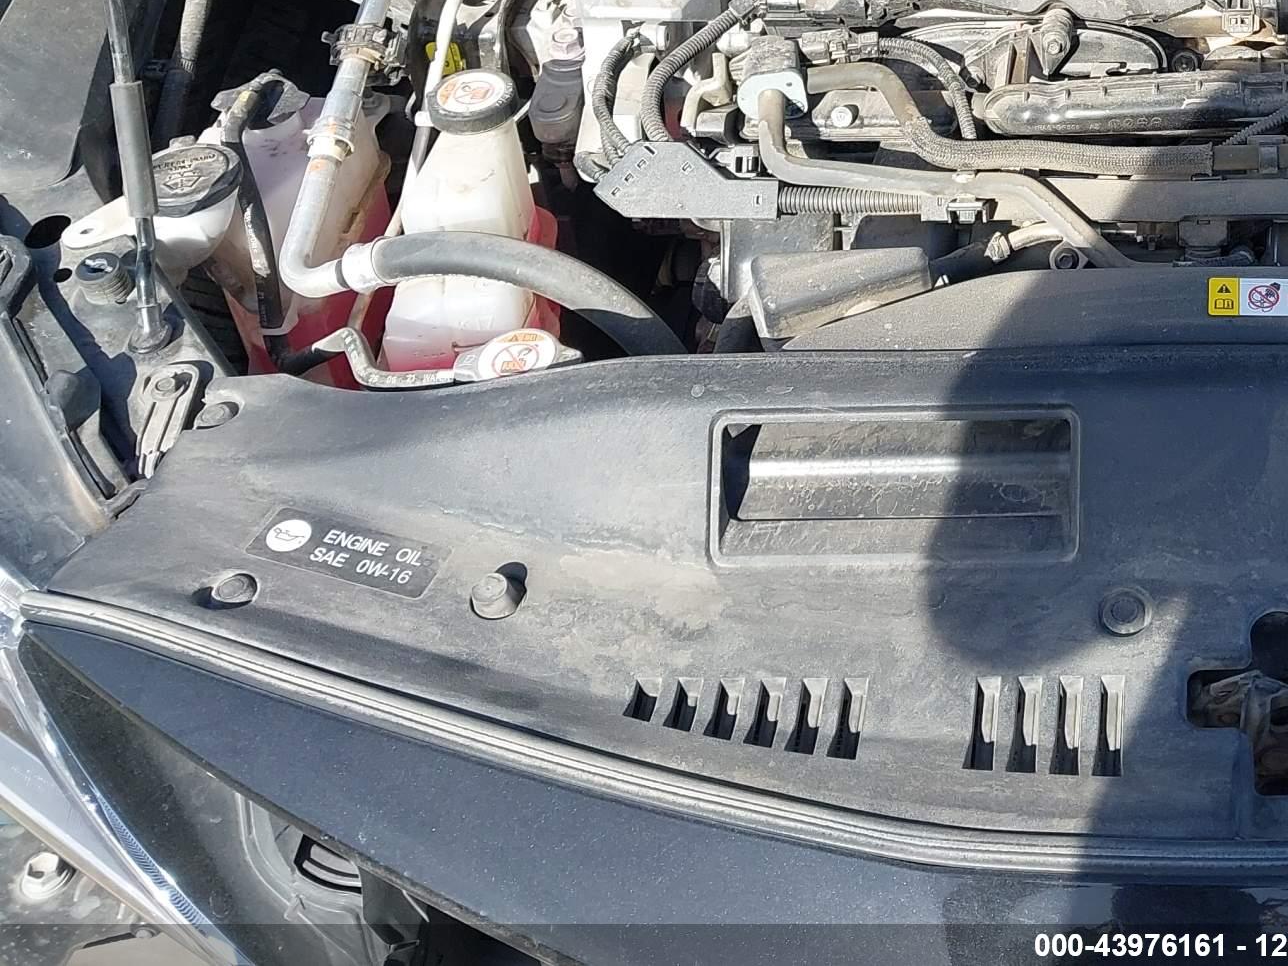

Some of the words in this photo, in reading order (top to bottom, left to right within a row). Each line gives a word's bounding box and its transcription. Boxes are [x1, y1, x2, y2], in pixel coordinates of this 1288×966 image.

[309, 547, 350, 568] SAE
[356, 559, 412, 584] 0W-16
[323, 529, 389, 557] ENGINE
[395, 548, 422, 566] OIL
